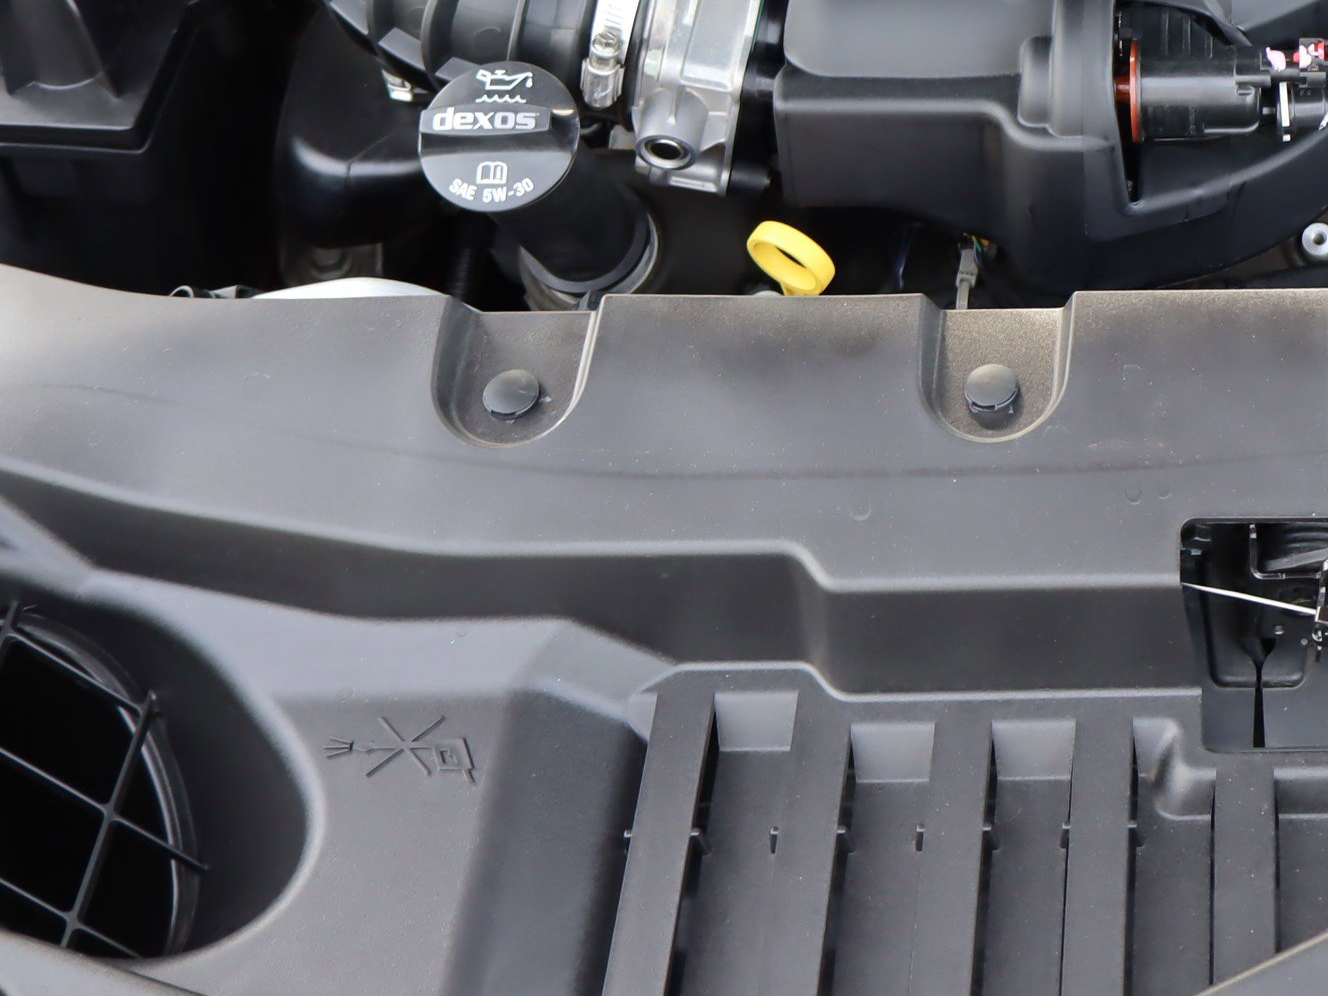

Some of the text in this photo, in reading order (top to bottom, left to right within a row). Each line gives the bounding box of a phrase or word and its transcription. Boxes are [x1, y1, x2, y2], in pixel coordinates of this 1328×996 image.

[432, 107, 537, 131] dexos
[449, 177, 535, 203] SAE 5W-30
